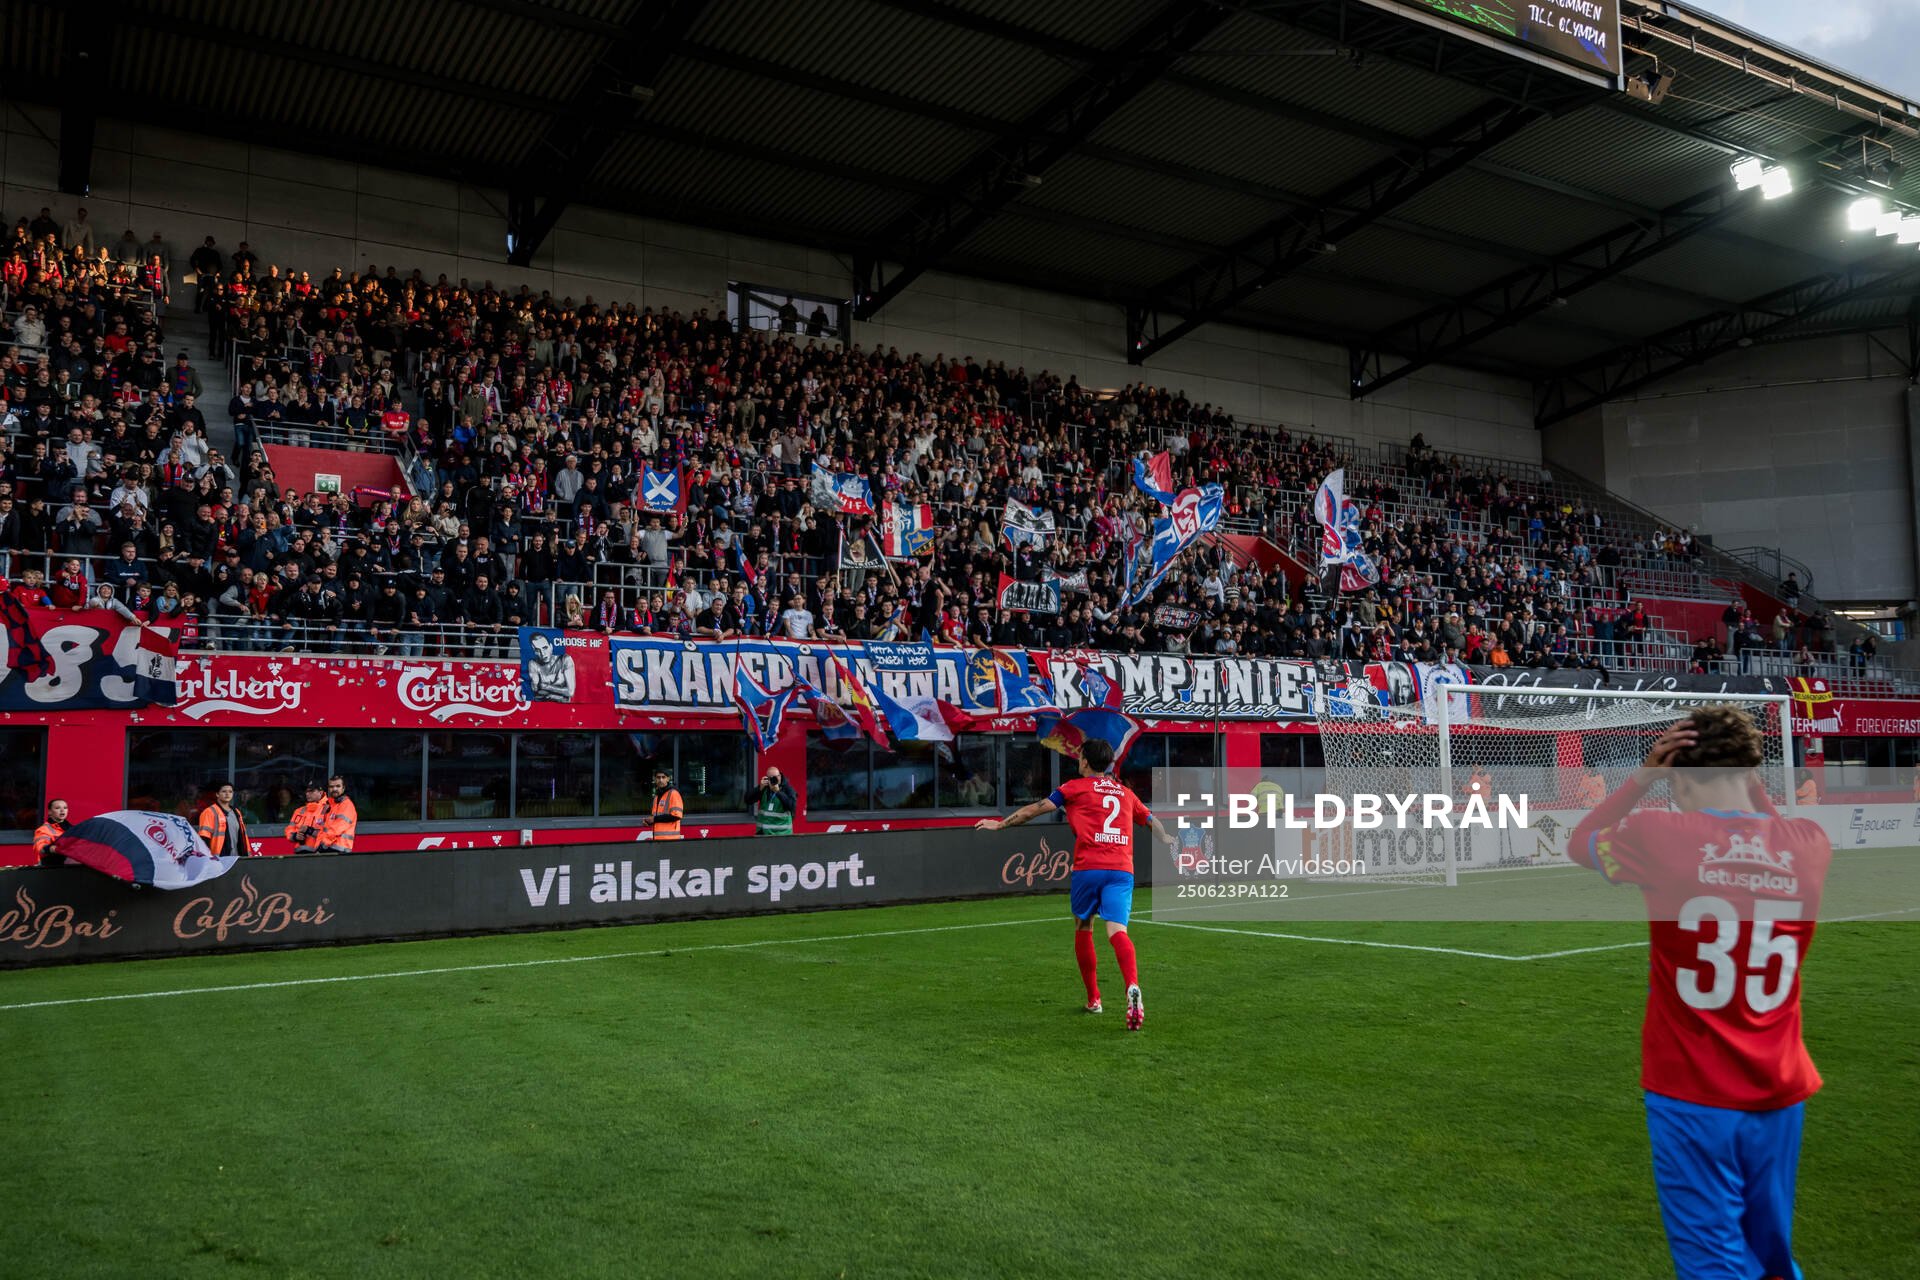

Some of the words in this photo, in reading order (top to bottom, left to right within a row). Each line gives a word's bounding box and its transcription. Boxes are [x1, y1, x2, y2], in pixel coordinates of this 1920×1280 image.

[1528, 4, 1554, 28] TILL
[1559, 17, 1606, 48] OLYMPIA
[1546, 0, 1602, 21] OMMEN
[553, 637, 587, 647] CHOOSE
[590, 639, 603, 648] HIF
[174, 661, 301, 709] arlsberg
[397, 666, 532, 711] Carlsberg
[1122, 695, 1281, 717] Helsingborg
[1102, 795, 1120, 834] 2
[1094, 832, 1129, 846] BIRKFELDT
[519, 865, 571, 907] Vi
[590, 858, 733, 904] älskar
[747, 853, 876, 901] sport.
[1698, 865, 1798, 894] letusplay
[1676, 896, 1803, 1013] 35
